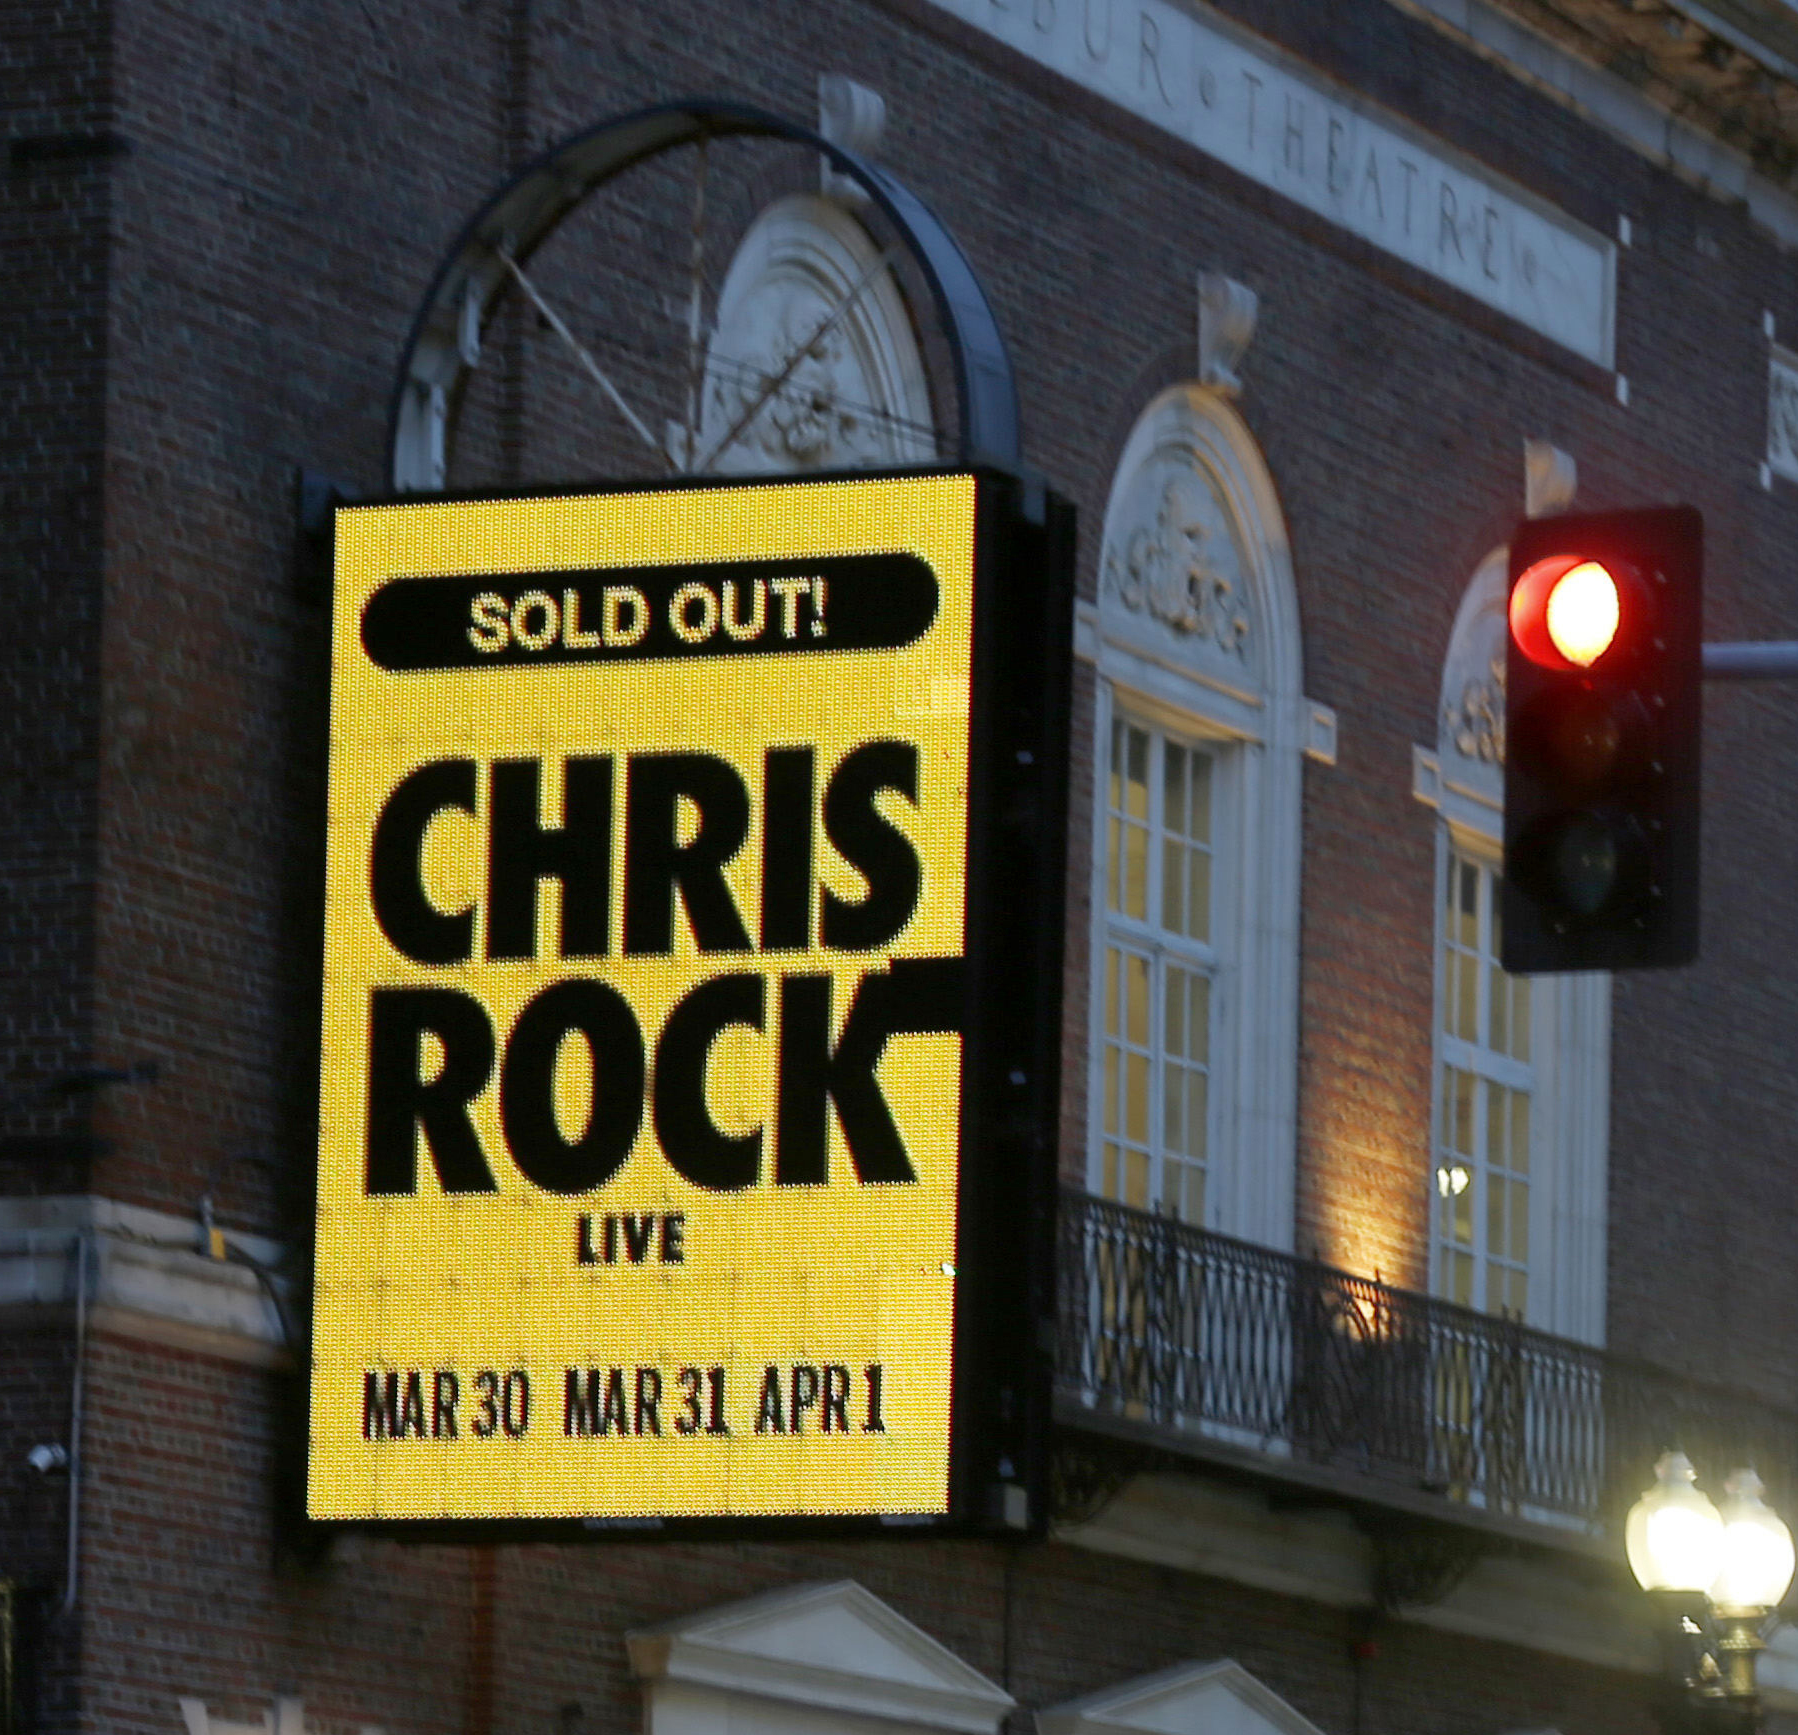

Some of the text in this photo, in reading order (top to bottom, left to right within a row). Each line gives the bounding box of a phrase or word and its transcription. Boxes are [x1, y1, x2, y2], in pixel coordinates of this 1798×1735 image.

[1241, 67, 1500, 283] THEATRE
[467, 576, 828, 653] SOLD OUT!
[370, 739, 922, 966] CHRIS
[365, 957, 965, 1197] ROCK
[577, 1211, 686, 1267] LIVE
[362, 1361, 886, 1440] MAR 30 MAR 31 APR 1
